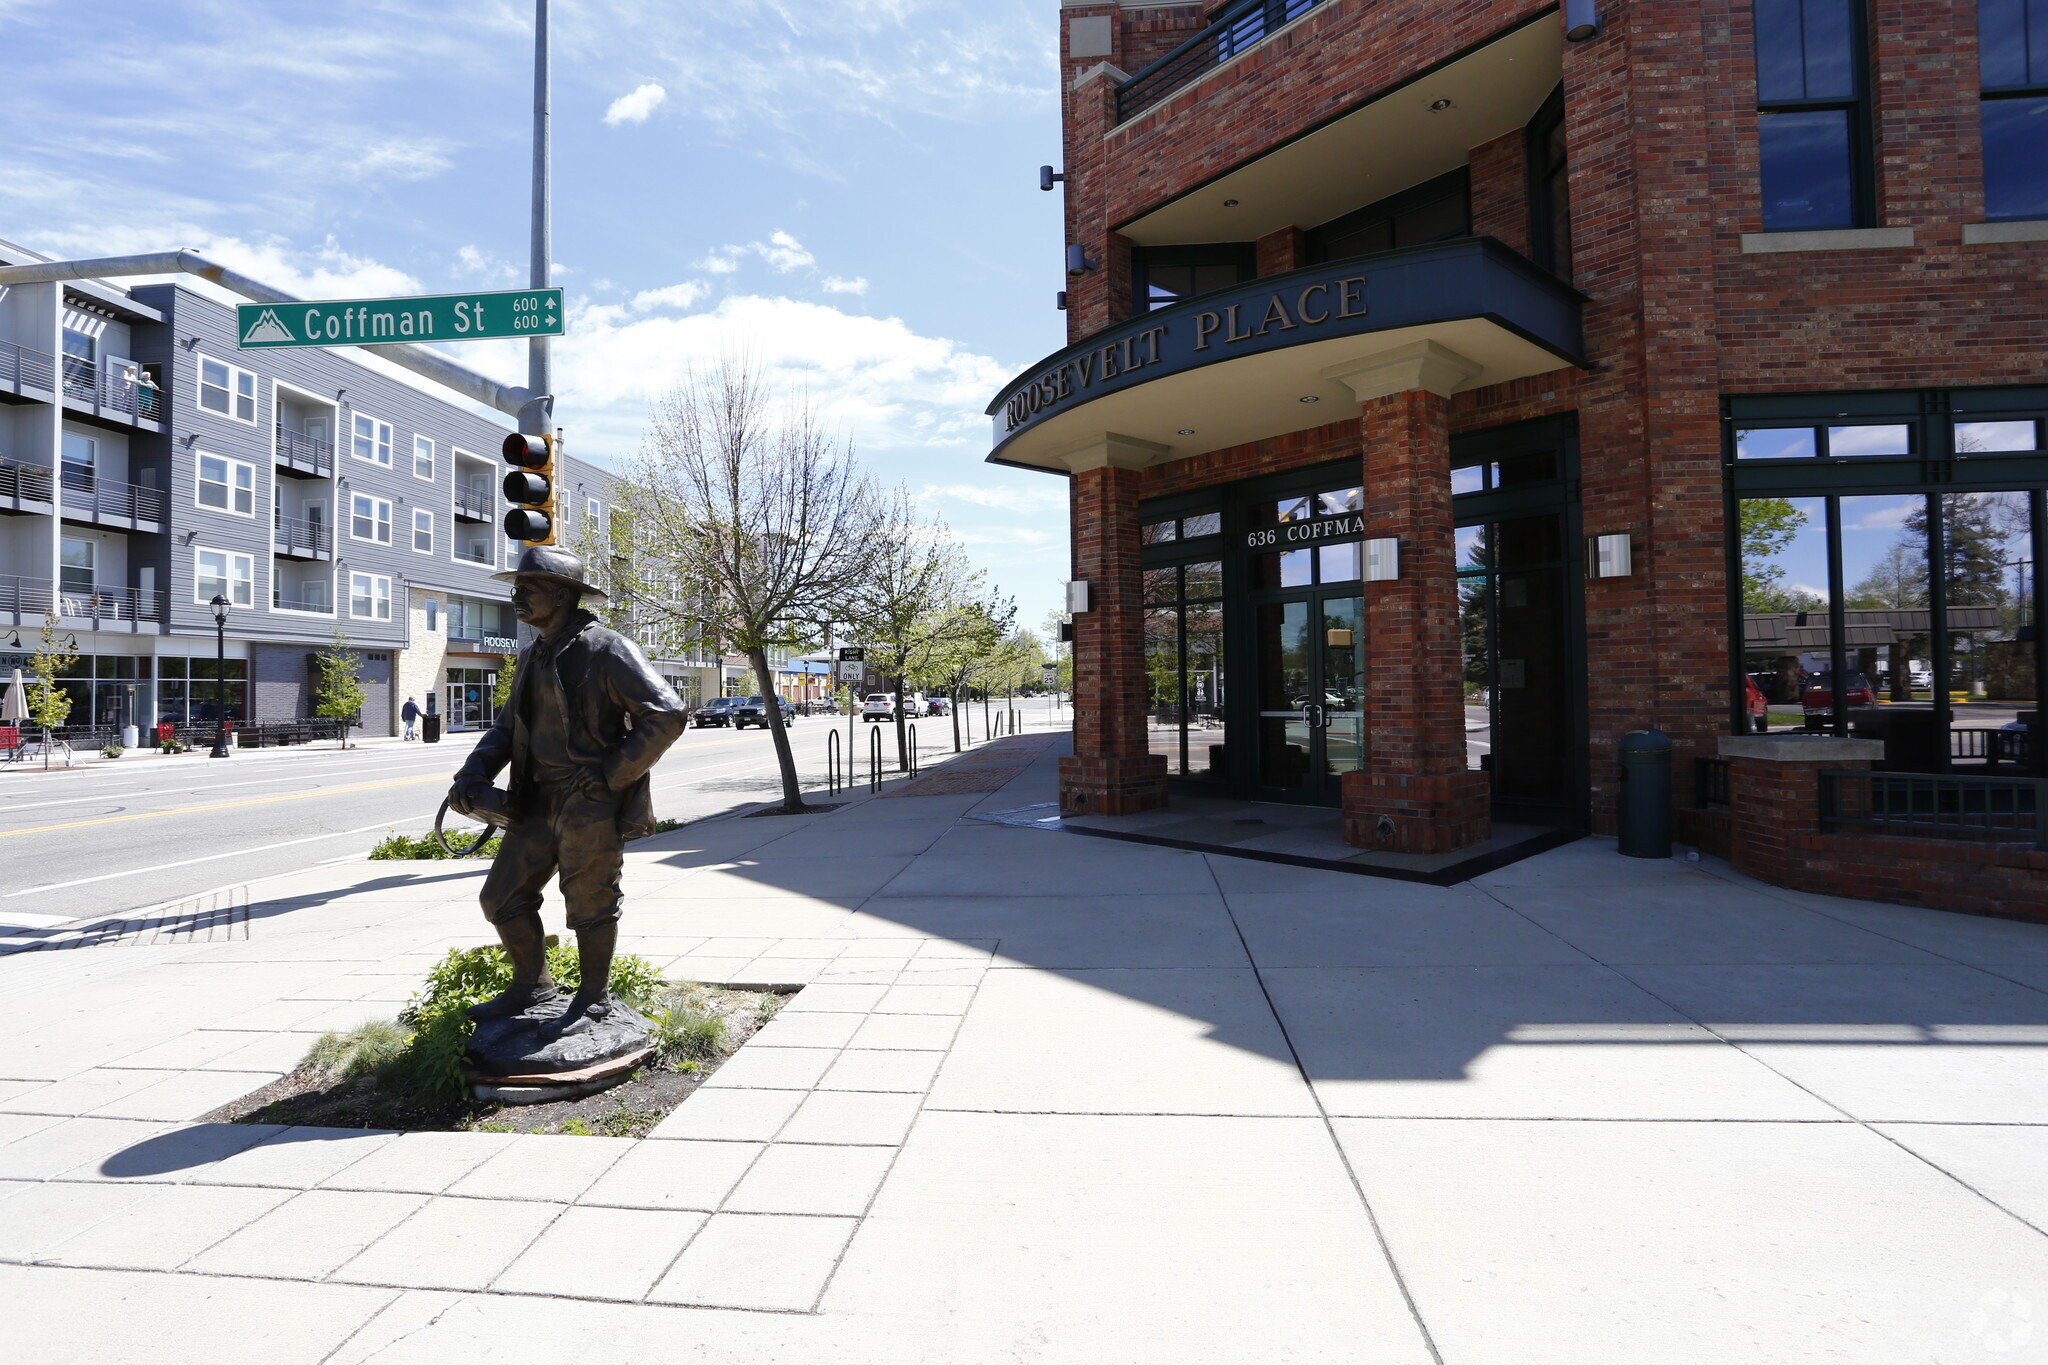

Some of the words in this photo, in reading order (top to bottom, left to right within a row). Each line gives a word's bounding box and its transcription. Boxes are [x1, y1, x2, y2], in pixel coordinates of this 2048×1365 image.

[513, 297, 538, 312] 600
[305, 307, 433, 340] Coffman
[454, 301, 485, 333] St
[513, 315, 539, 329] 600
[1005, 324, 1167, 432] ROOSEVELT
[1192, 276, 1368, 351] PLACE
[1248, 530, 1276, 547] 636
[843, 672, 860, 680] ONLY
